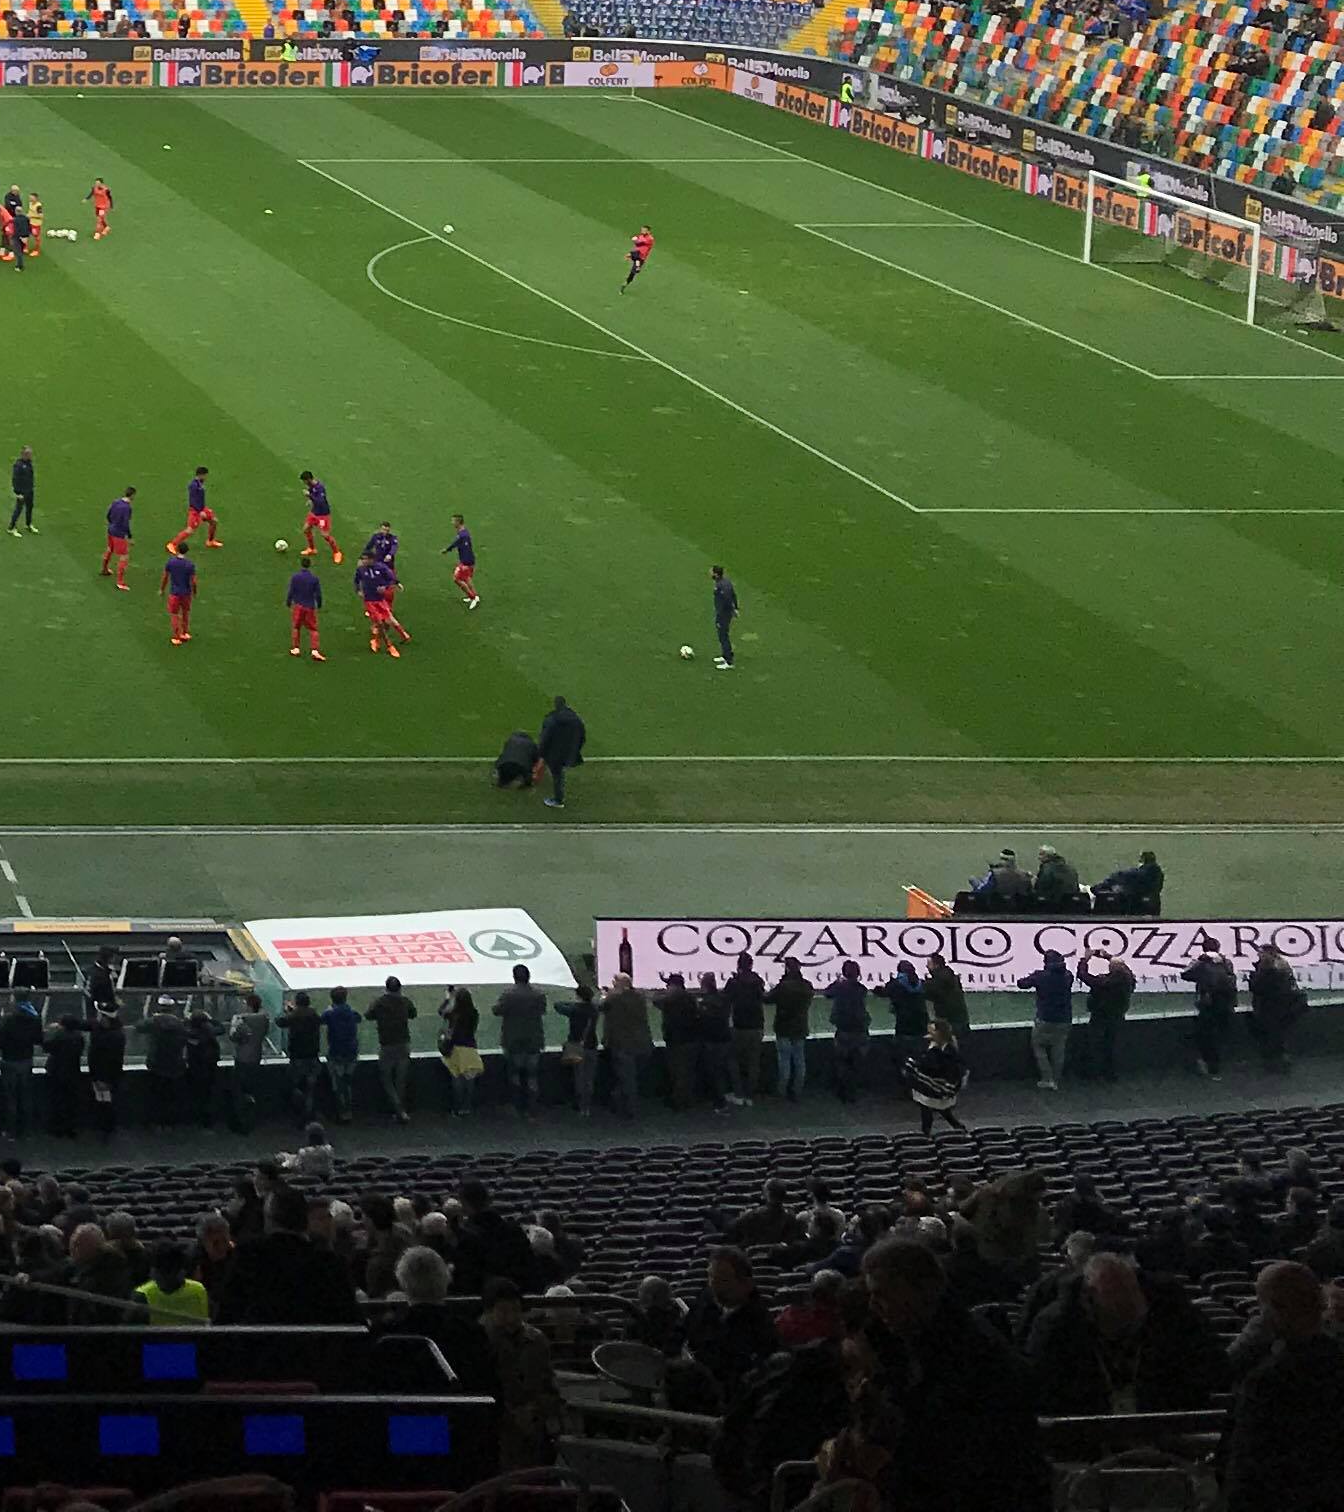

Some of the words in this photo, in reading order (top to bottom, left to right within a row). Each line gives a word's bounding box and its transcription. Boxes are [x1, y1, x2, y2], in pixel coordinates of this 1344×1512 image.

[31, 62, 147, 85] Bricofer
[204, 62, 319, 85] Bricofer
[377, 62, 492, 84] Bricofer
[853, 112, 916, 154] Bricofer
[657, 923, 1014, 968] COZZAROLO
[1034, 924, 1344, 968] COZZAROL
[959, 973, 1015, 983] RIULI
